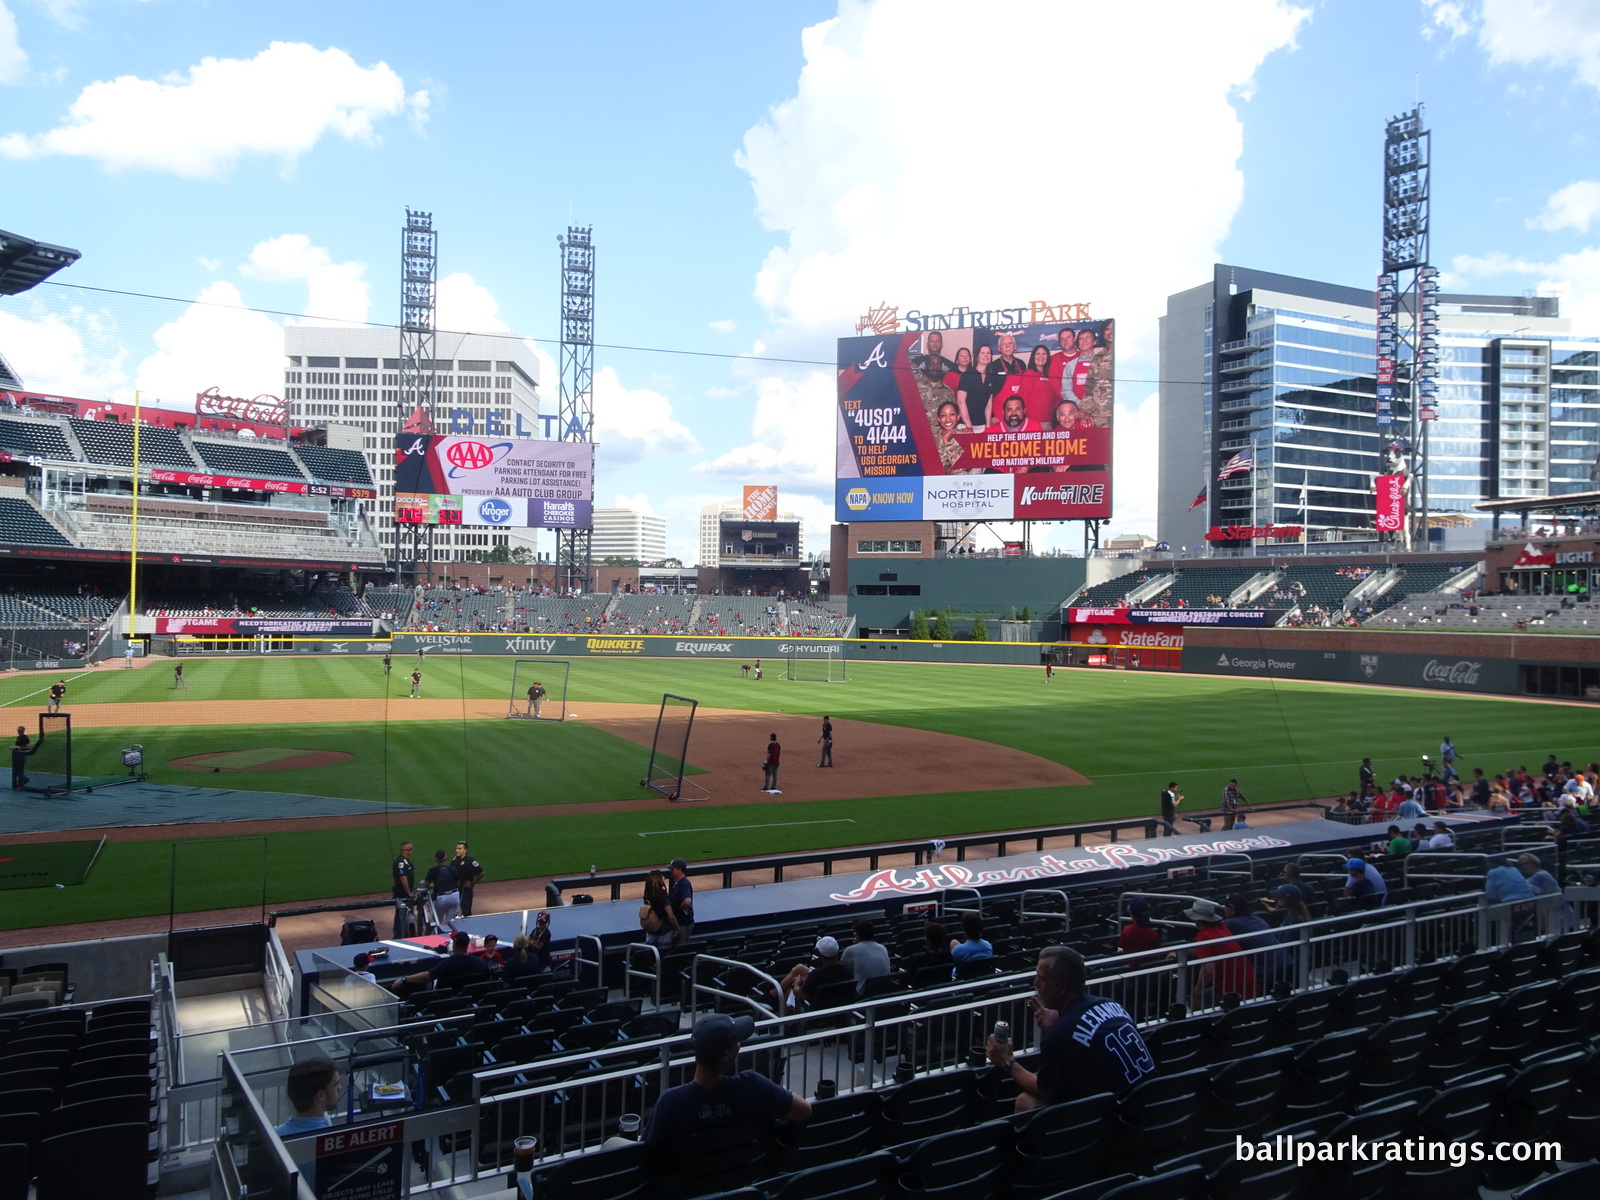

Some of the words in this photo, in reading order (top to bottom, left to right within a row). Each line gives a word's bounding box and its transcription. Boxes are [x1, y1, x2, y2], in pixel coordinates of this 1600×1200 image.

[1029, 300, 1091, 323] PARK
[1379, 374, 1390, 382] 1957
[844, 400, 862, 410] TEXT
[452, 409, 586, 440] DELTA
[854, 436, 864, 444] TO
[867, 425, 906, 444] 41444
[988, 434, 1002, 442] HELP
[1004, 433, 1016, 442] THE
[1017, 432, 1040, 440] BRAVES
[1042, 432, 1055, 440] AND
[1057, 431, 1070, 439] USO
[857, 446, 867, 454] TO
[868, 445, 887, 454] HELP
[970, 441, 1041, 458] WELCOME
[1045, 439, 1088, 456] HOME
[451, 442, 489, 468] AAA
[861, 456, 876, 466] USO
[878, 454, 917, 464] GEORGIA'S
[992, 458, 1004, 466] OUR
[1036, 456, 1065, 465] MILITARY
[27, 456, 42, 467] 42
[507, 459, 534, 468] CONTACT
[536, 460, 566, 468] SECURITY
[494, 468, 522, 476] PARKING
[523, 469, 558, 477] ATTENDANT
[560, 470, 572, 478] FOR
[864, 466, 896, 476] MISSION
[501, 477, 528, 485] PARKING
[530, 478, 540, 486] LOT
[310, 486, 327, 494] 5:52
[495, 488, 510, 496] AAA
[512, 488, 532, 498] AUTO
[534, 489, 554, 498] CLUB
[556, 490, 582, 500] GROUP
[746, 488, 761, 503] THE
[927, 488, 1010, 500] NORTHSIDE
[1061, 484, 1104, 504] TIRE
[743, 485, 777, 519] HOME
[850, 493, 867, 504] NAPA
[872, 493, 894, 504] KNOW
[896, 492, 914, 503] HOW
[482, 502, 510, 522] Kroger
[756, 499, 777, 519] DEPOT
[1556, 551, 1594, 564] LIGHT
[414, 636, 471, 645] WELLSTAR
[506, 637, 556, 653] xfinity
[586, 638, 644, 650] QUIKRETE
[675, 641, 732, 654] EQUIFAX
[1232, 658, 1266, 669] Georgia
[1268, 658, 1296, 669] Power
[830, 853, 1093, 900] Atlanta
[1085, 835, 1292, 870] Braves
[1105, 1023, 1154, 1084] 13
[324, 1135, 345, 1152] BE
[350, 1125, 396, 1146] ALERT
[322, 1188, 354, 1200] OBJECTS
[356, 1185, 371, 1193] MAY
[373, 1179, 395, 1188] LEAVE
[373, 1187, 392, 1196] FIELD
